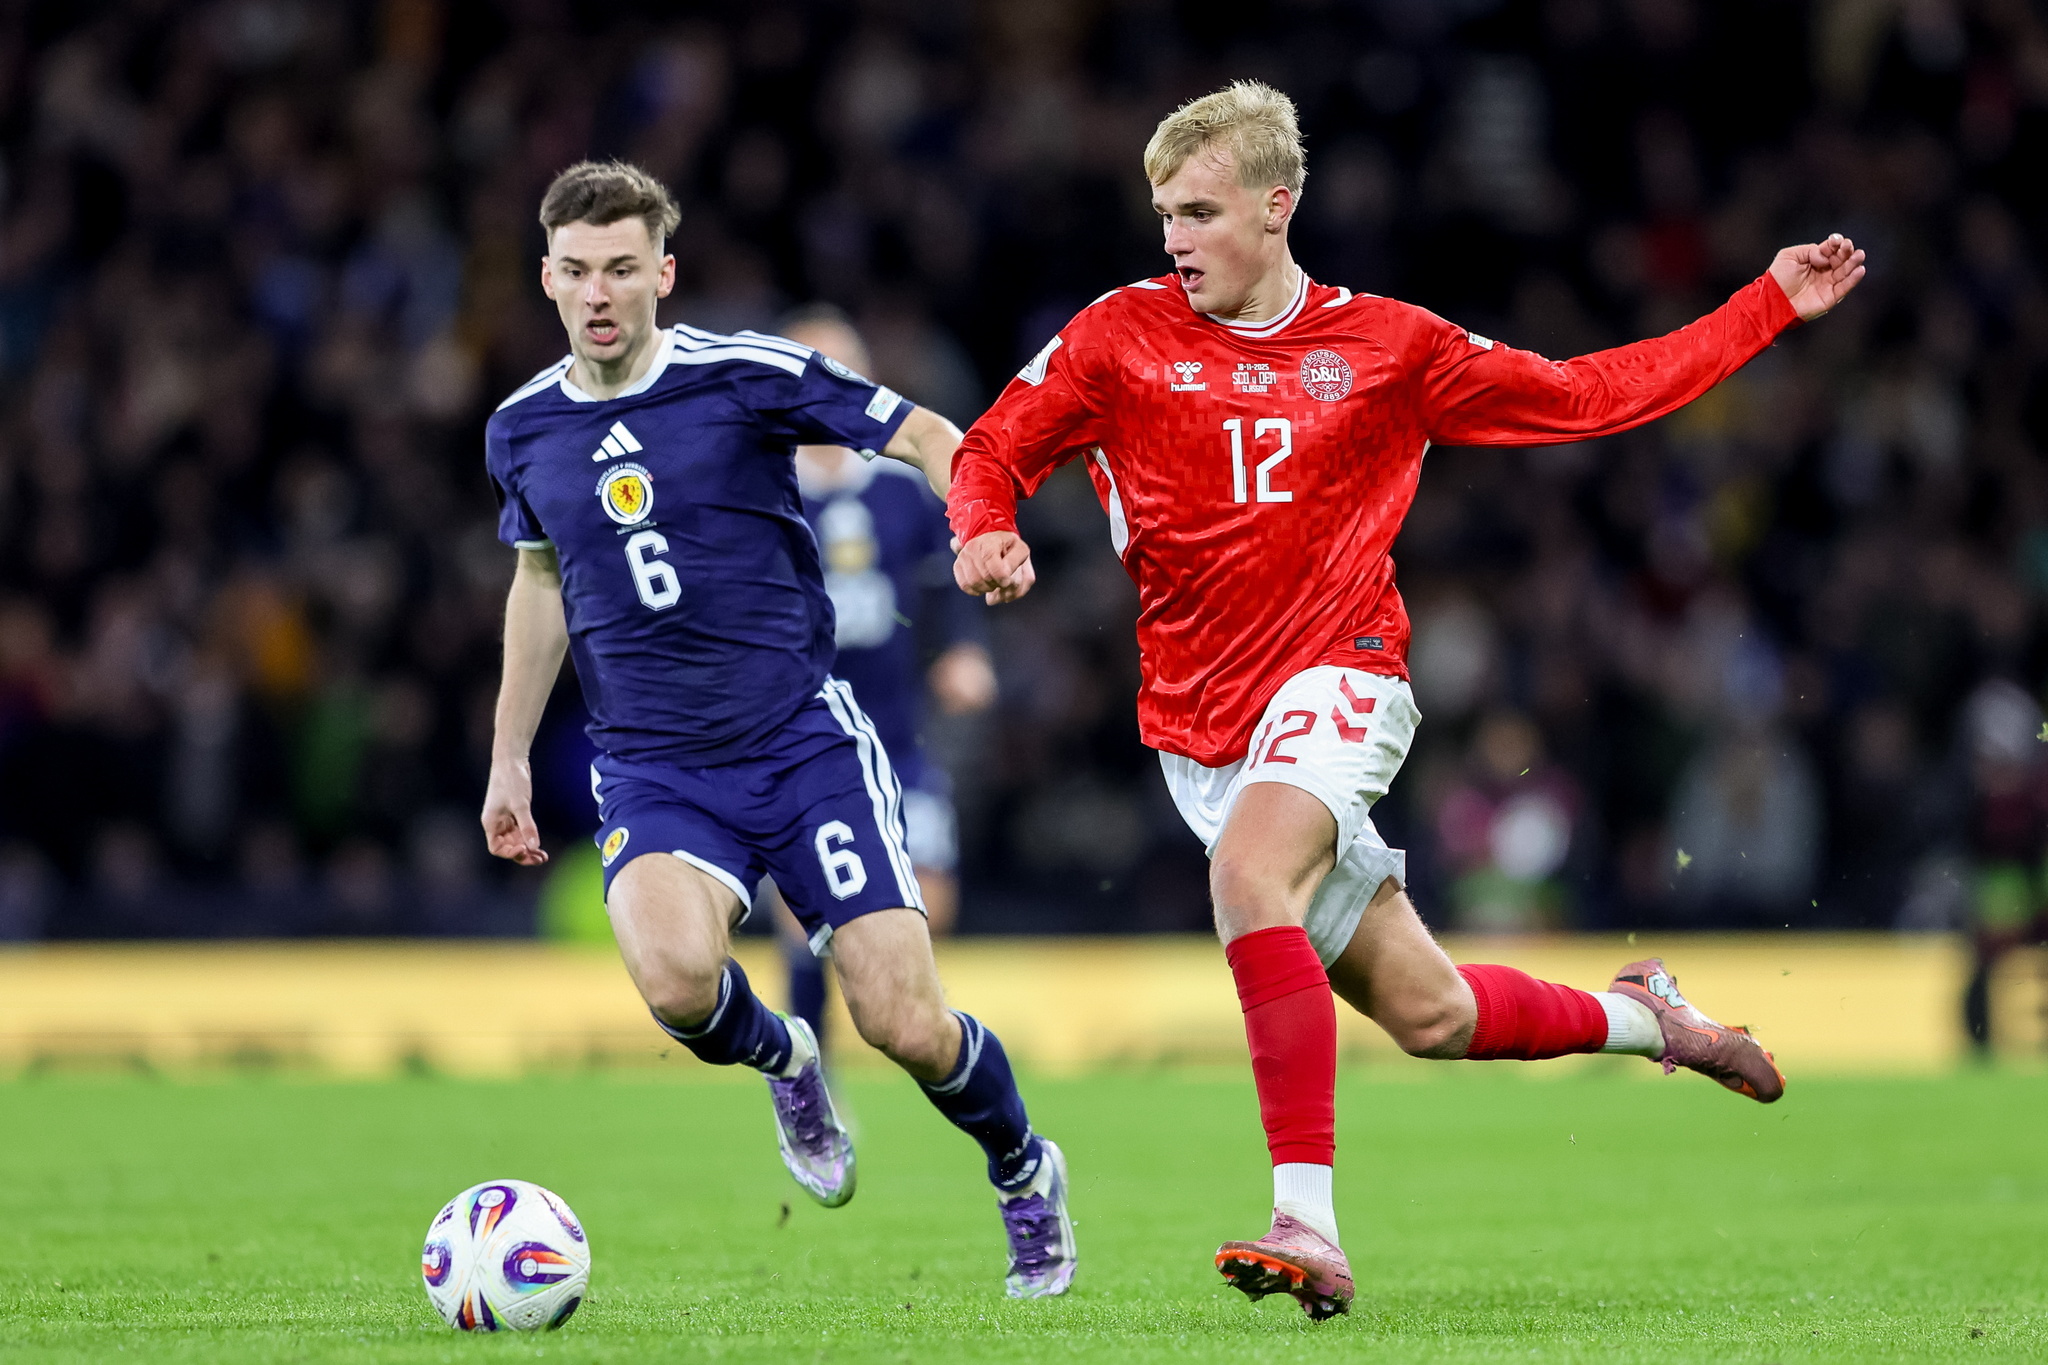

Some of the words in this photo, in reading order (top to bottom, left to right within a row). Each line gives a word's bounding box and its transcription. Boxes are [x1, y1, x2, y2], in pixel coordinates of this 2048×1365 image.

[1236, 363, 1270, 371] 18-11-2025
[1309, 366, 1342, 382] DBU
[1231, 371, 1250, 385] SCO
[1258, 371, 1277, 385] DEN
[1302, 364, 1316, 395] DANSK
[1341, 365, 1351, 393] UNION
[1170, 382, 1206, 392] hummel
[1241, 385, 1268, 393] GLASGOW
[1319, 392, 1341, 400] 1889
[1222, 417, 1293, 503] 12
[624, 529, 682, 612] 6
[1249, 710, 1318, 771] 12
[814, 820, 868, 901] 6
